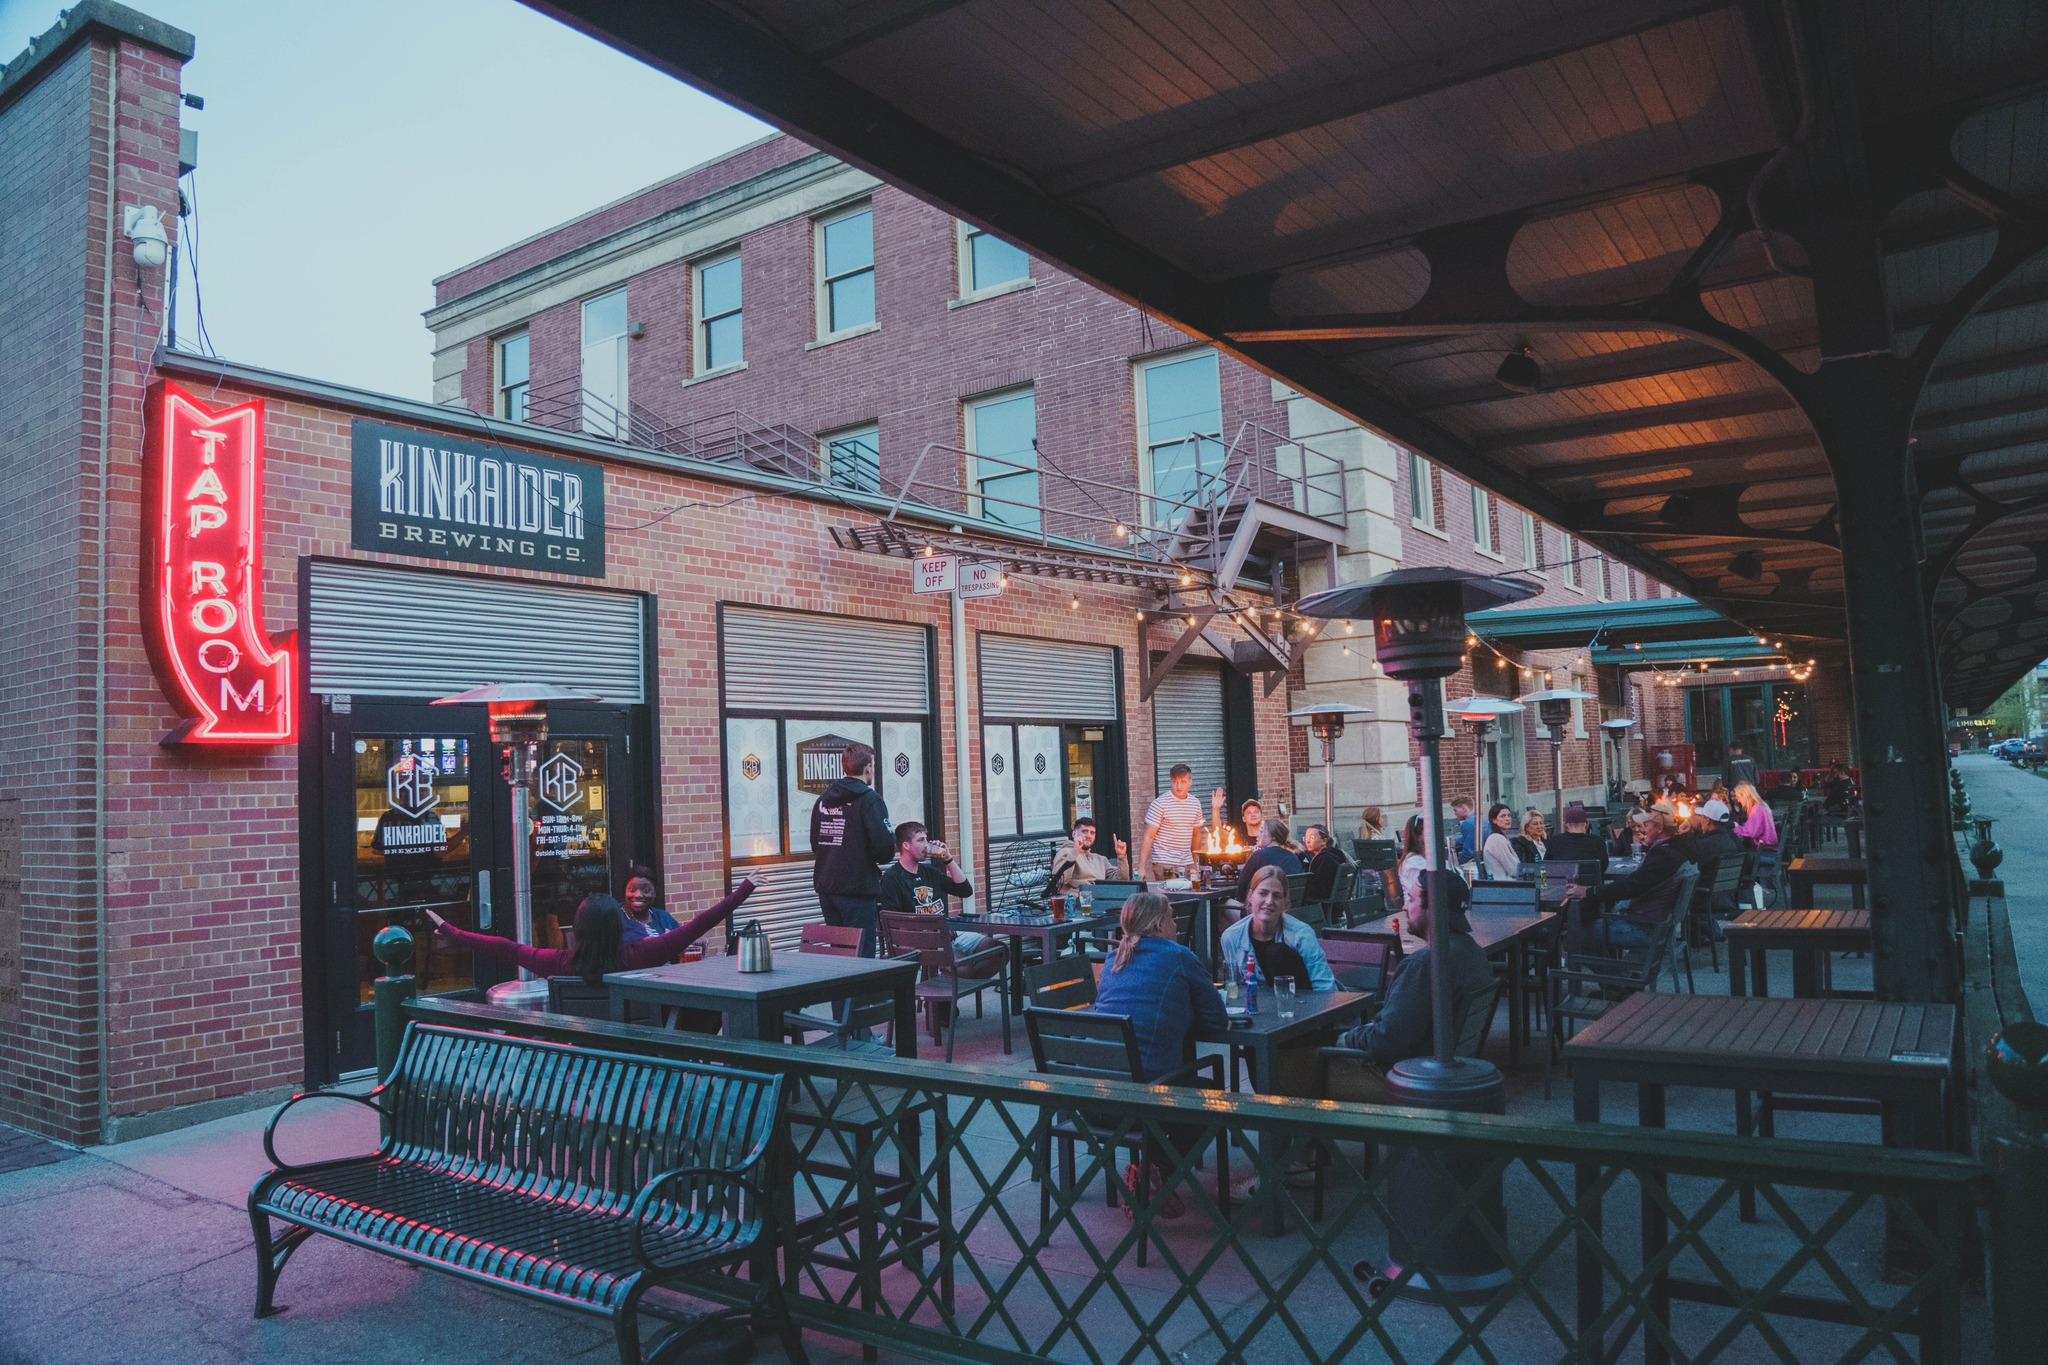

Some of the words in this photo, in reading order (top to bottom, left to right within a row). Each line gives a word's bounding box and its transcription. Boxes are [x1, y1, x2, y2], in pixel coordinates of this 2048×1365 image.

[187, 430, 228, 537] TAP
[379, 439, 585, 540] KINKAIDER
[379, 522, 535, 556] BREWING
[922, 561, 947, 573] KEEP
[973, 569, 986, 580] NO
[925, 576, 944, 587] OFF
[961, 581, 1000, 592] TRESPASSING
[190, 561, 265, 712] ROOM
[383, 824, 447, 846] KINKAIDER
[384, 846, 431, 855] BREWING
[555, 849, 568, 857] Food
